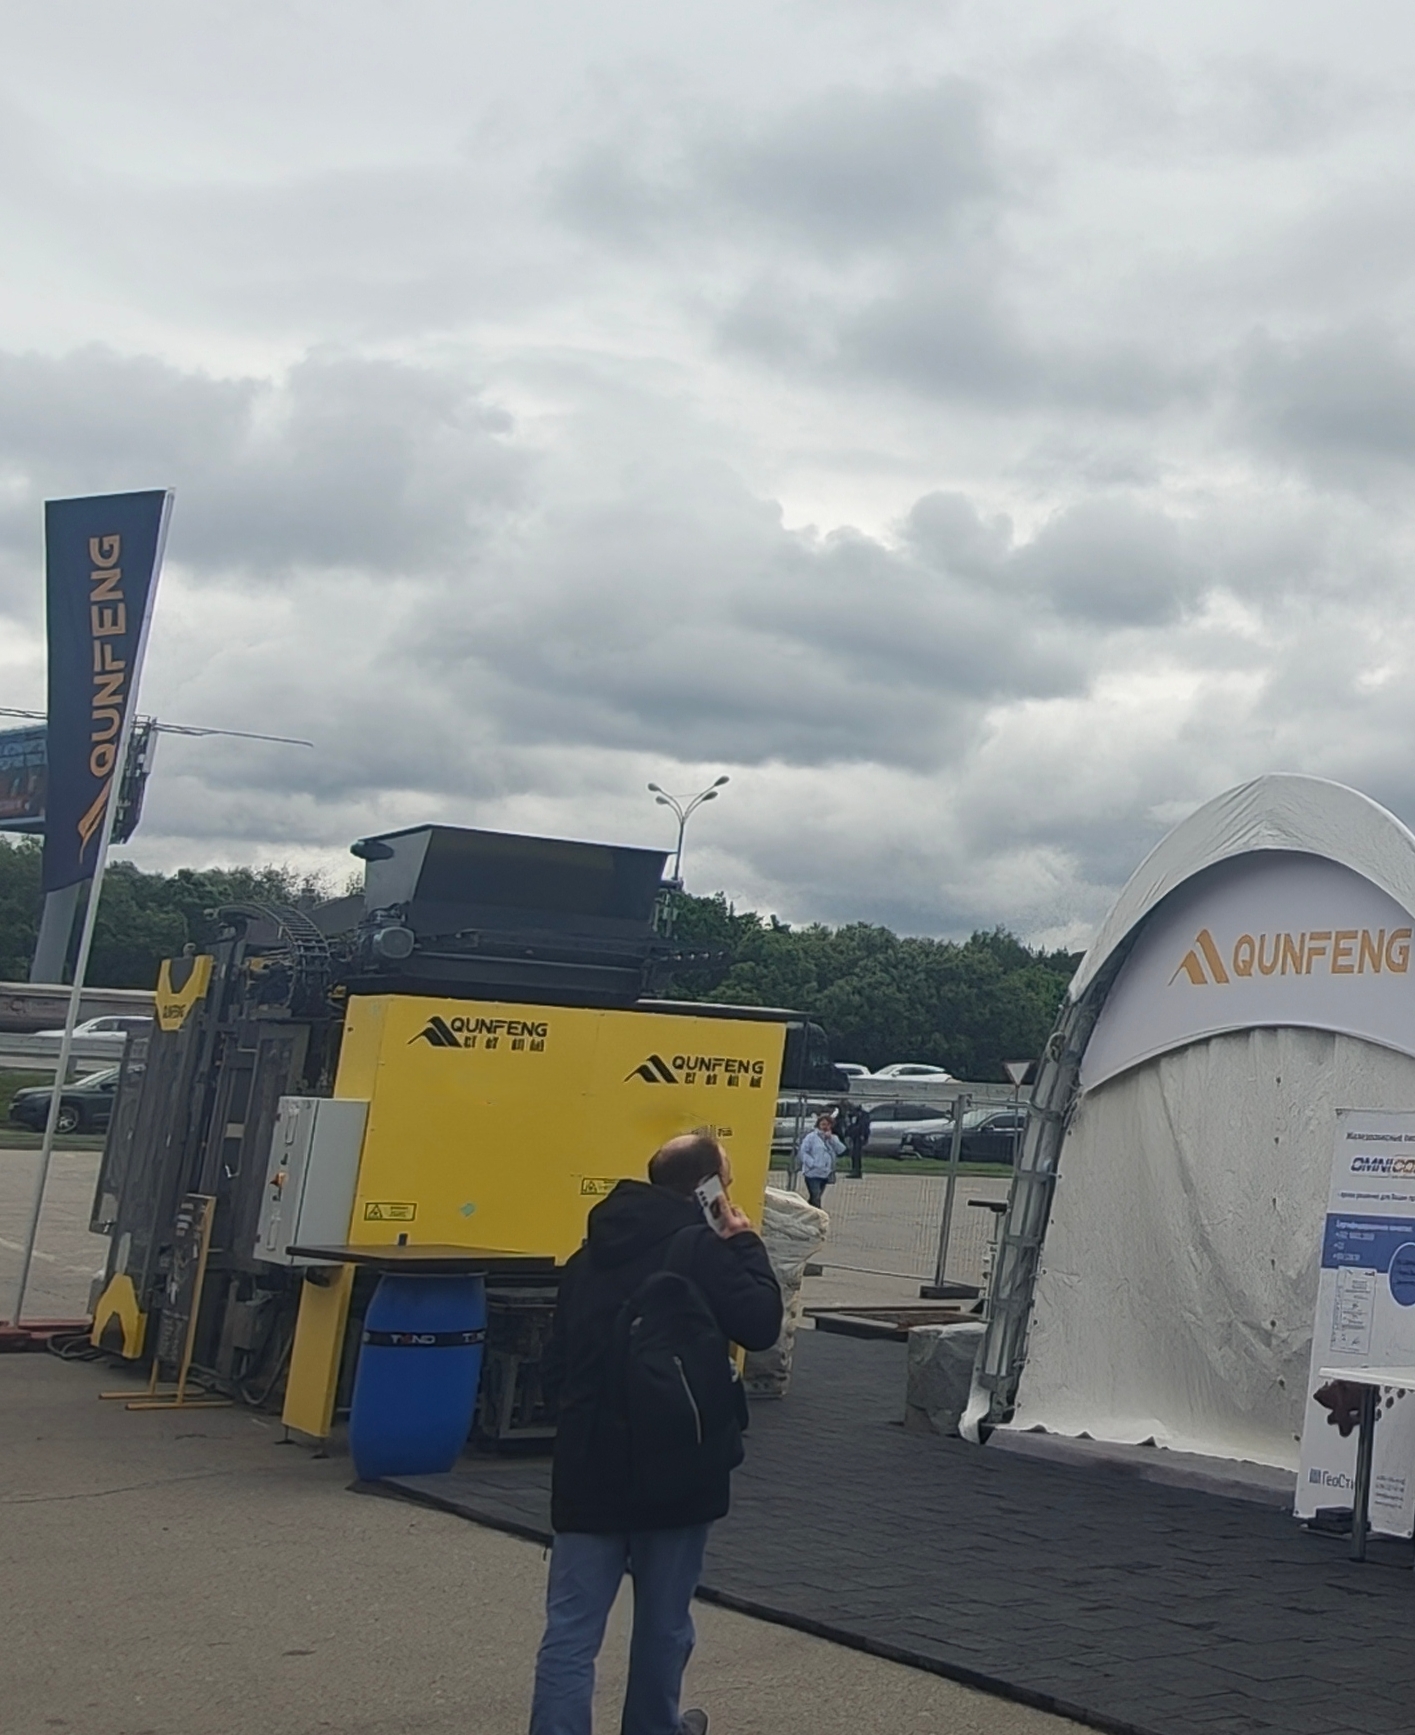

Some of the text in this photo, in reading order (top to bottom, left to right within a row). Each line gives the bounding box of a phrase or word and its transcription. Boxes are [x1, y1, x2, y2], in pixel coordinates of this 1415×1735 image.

[89, 534, 126, 777] QUNFENG
[1232, 928, 1412, 977] QUNFENG
[450, 1017, 548, 1038] QUNFENG
[672, 1055, 764, 1075] QUNFENG
